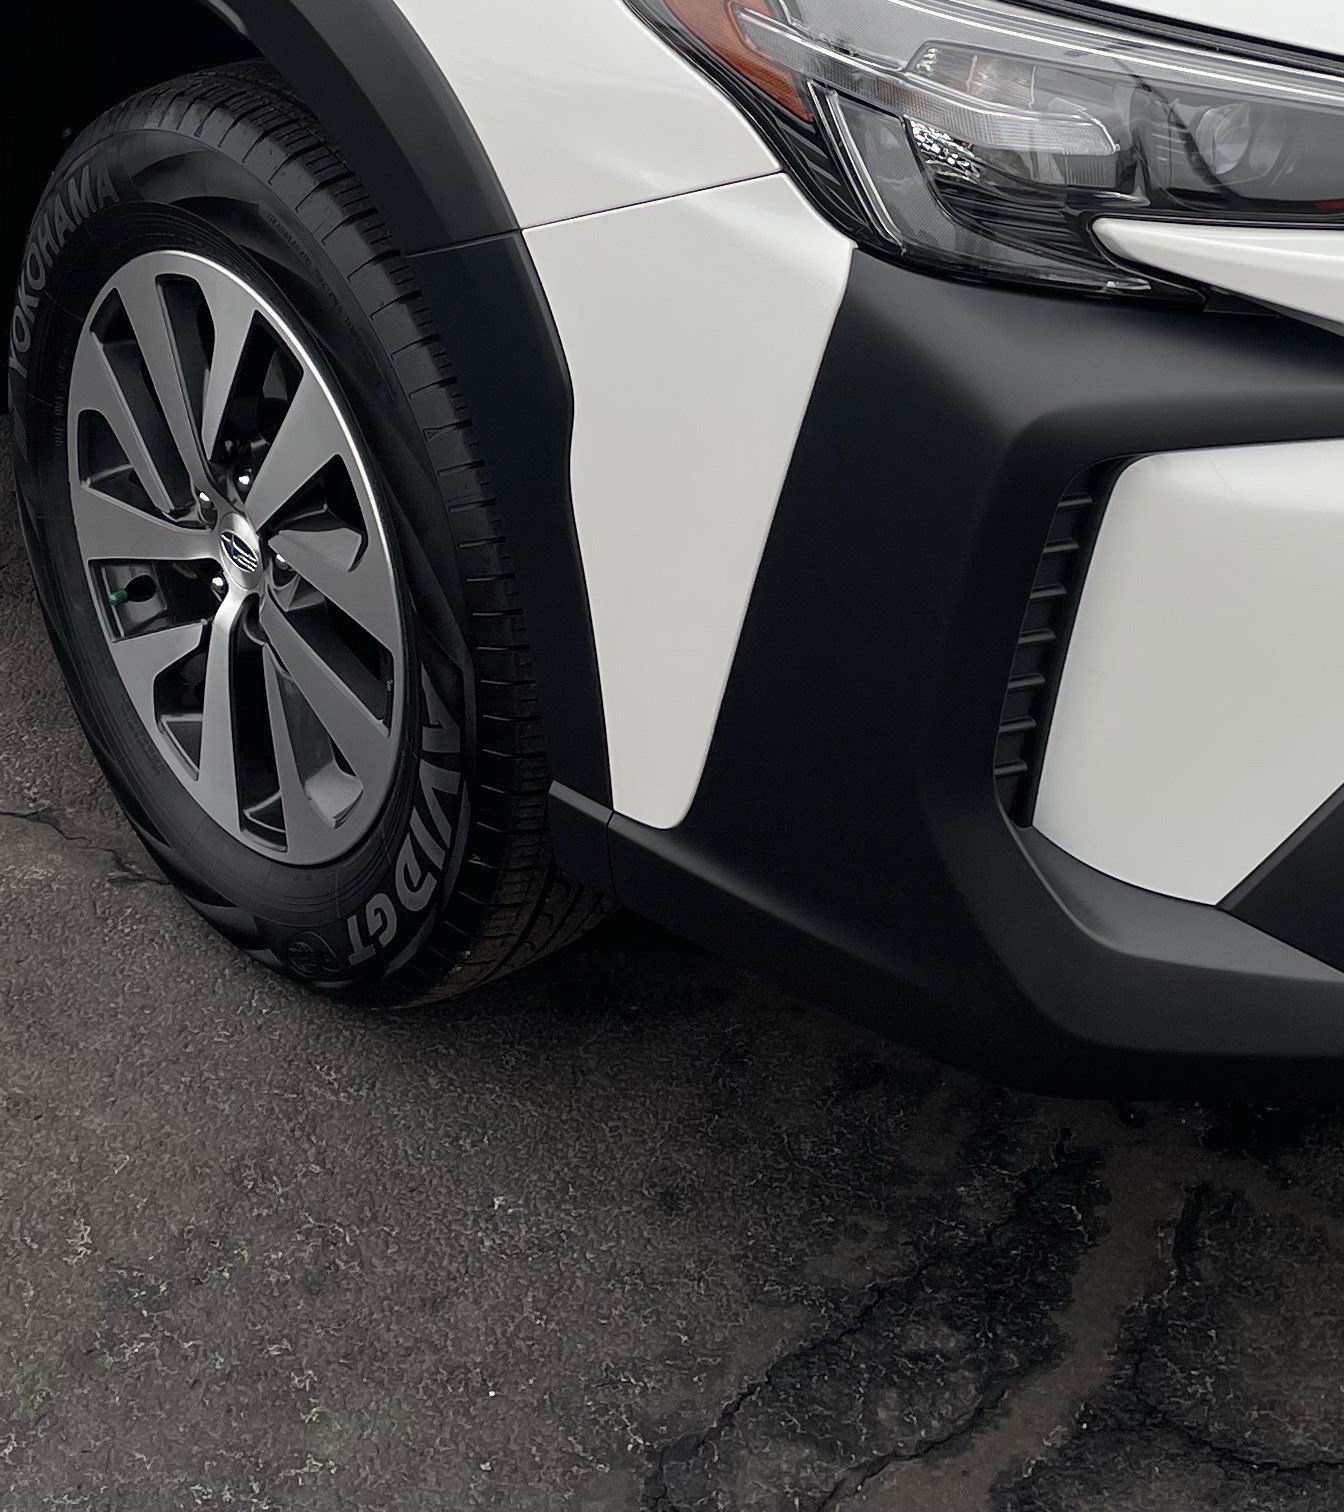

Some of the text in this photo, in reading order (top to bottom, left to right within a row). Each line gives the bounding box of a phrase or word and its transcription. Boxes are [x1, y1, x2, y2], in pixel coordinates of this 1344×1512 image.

[8, 161, 121, 379] YOKOHAMA
[347, 660, 462, 968] AVID GT
